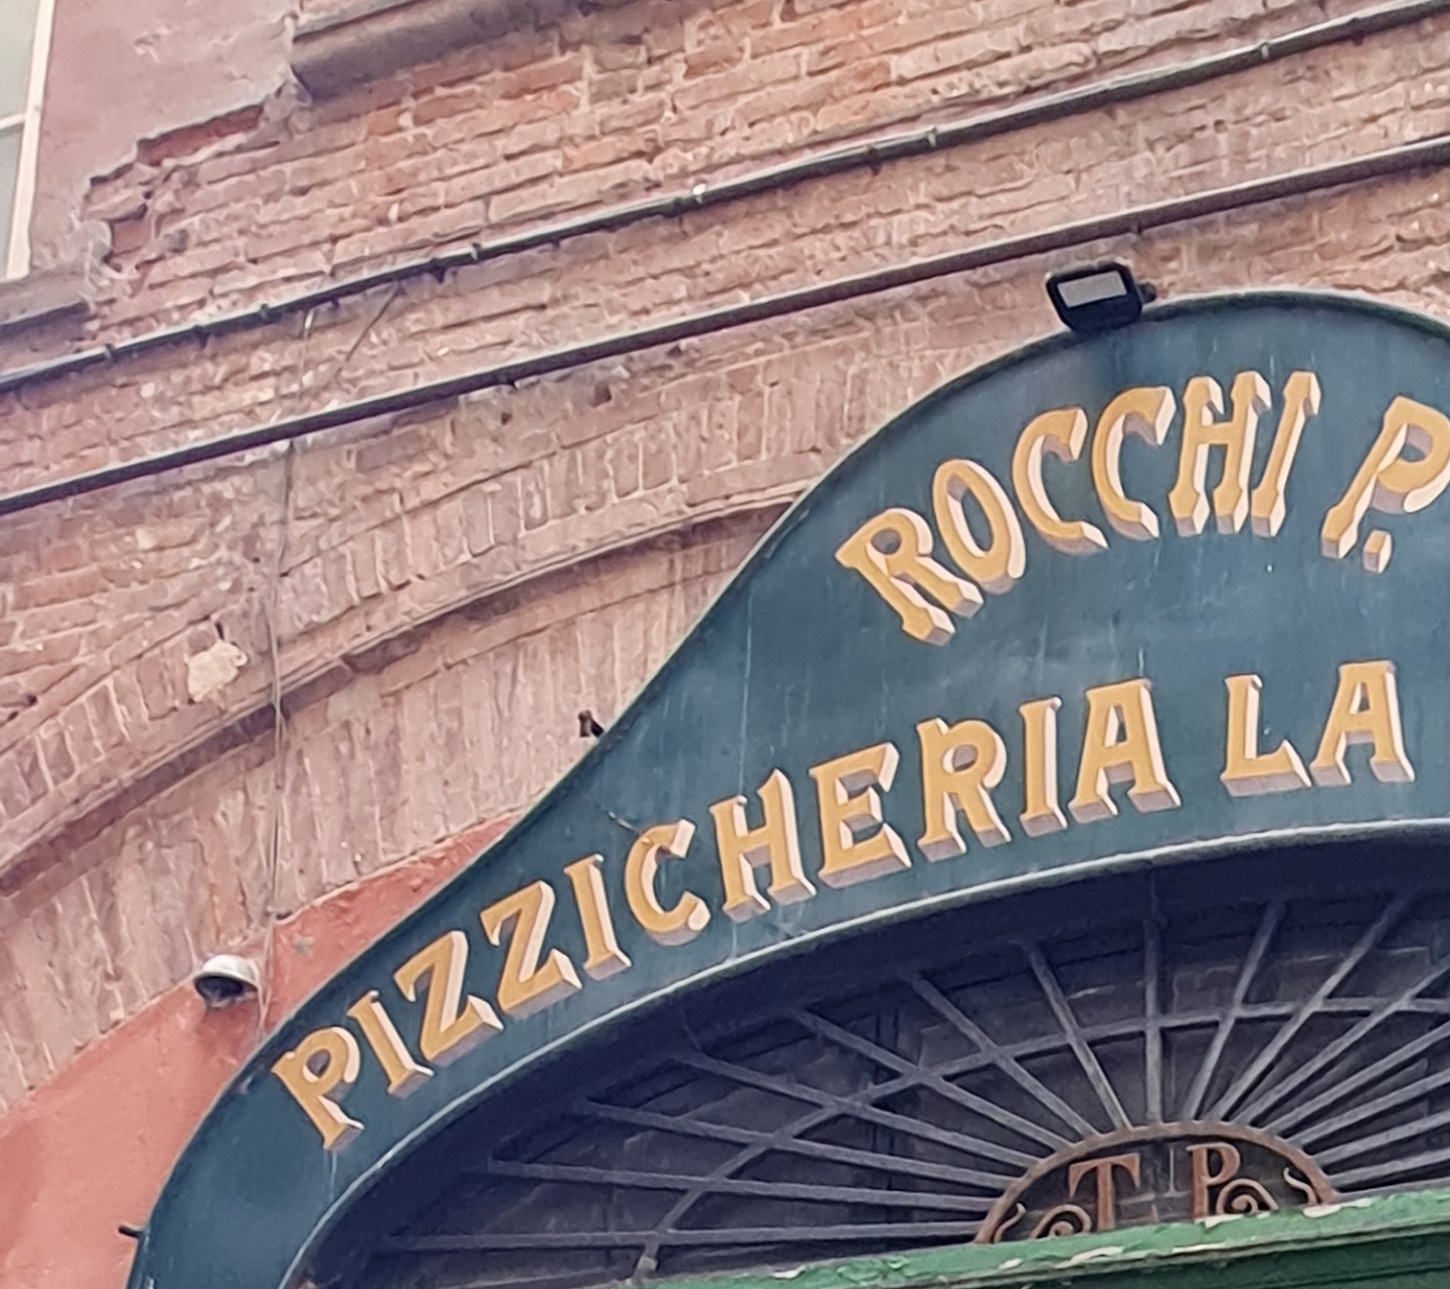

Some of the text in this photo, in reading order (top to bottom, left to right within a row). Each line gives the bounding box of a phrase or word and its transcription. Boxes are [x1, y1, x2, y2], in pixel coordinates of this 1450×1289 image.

[835, 370, 1320, 645] ROCCHI
[271, 677, 1182, 1152] PIZZICHERIA
[1220, 660, 1414, 797] LA
